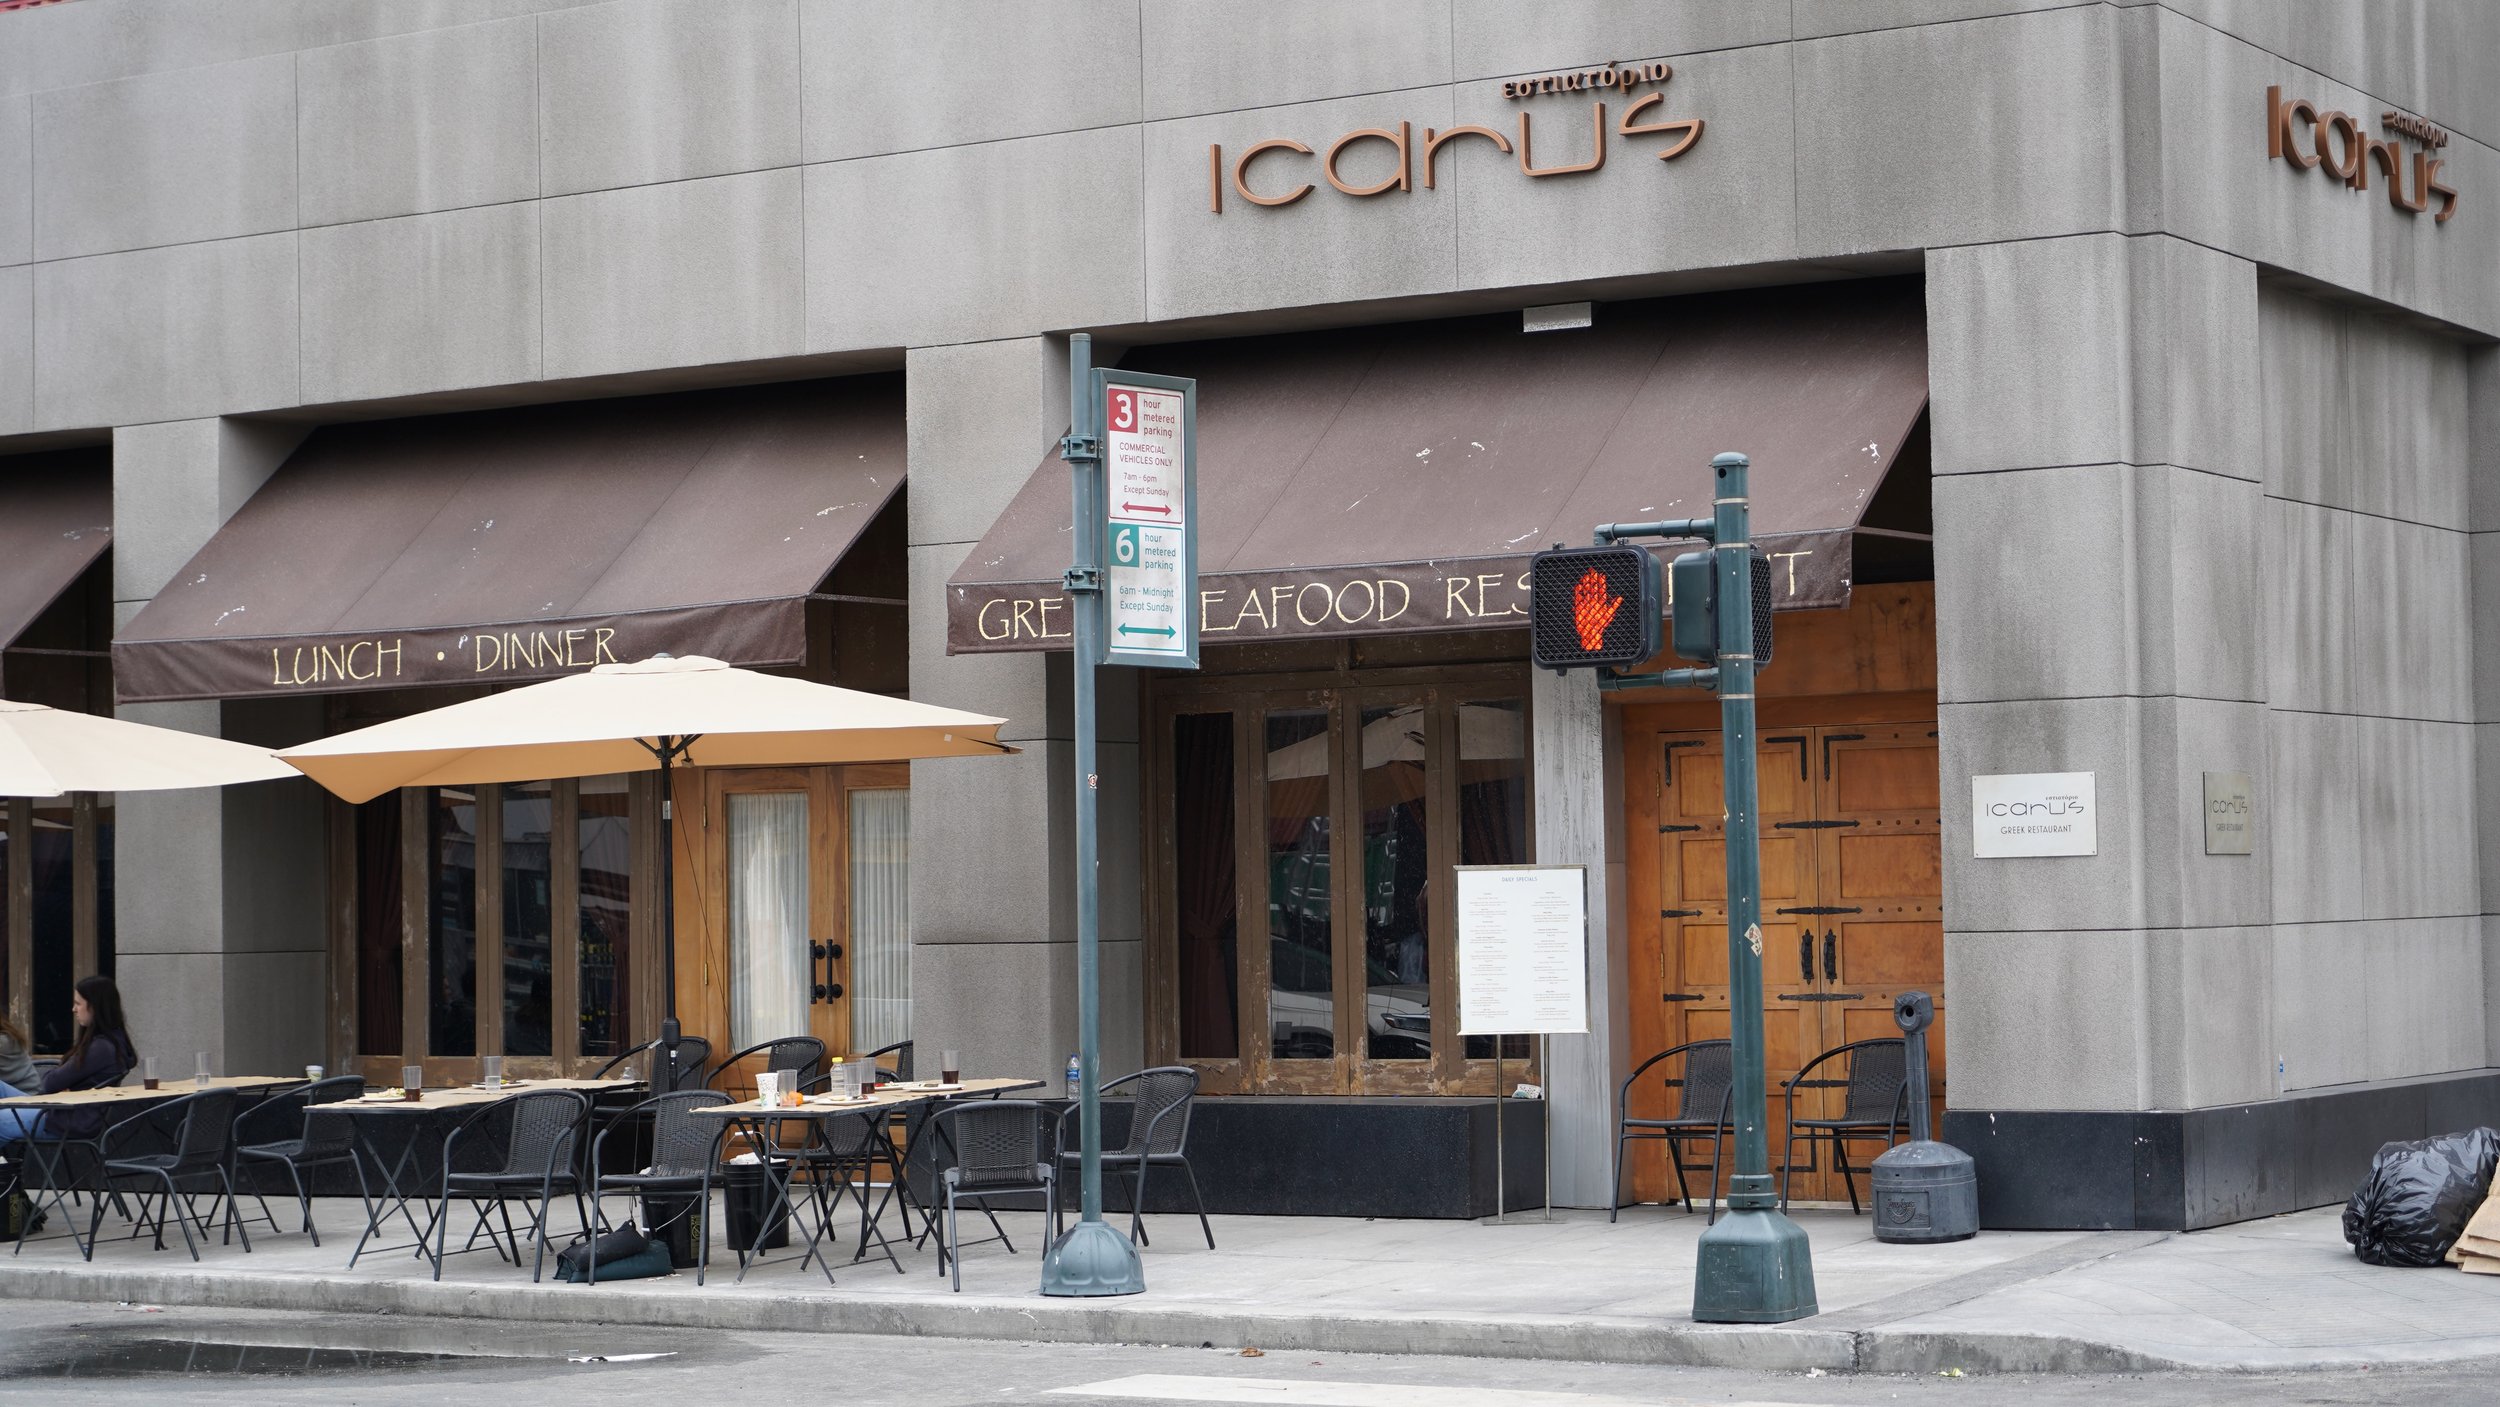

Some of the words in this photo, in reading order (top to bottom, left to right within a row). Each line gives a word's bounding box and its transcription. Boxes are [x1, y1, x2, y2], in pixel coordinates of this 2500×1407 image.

[1143, 399, 1161, 409] hour
[1114, 393, 1133, 429] 3
[1143, 413, 1175, 424] metered
[1143, 426, 1173, 439] parking
[1119, 442, 1166, 455] COMMERCIAL
[1119, 455, 1154, 465] VEHICLES
[1155, 457, 1173, 467] ONLY
[1123, 472, 1138, 480] 7am
[1142, 474, 1158, 483] 6pm
[1123, 485, 1145, 495] Except
[1146, 487, 1170, 497] Sunday
[1144, 533, 1162, 543] hour
[1115, 528, 1135, 563] 6
[1144, 547, 1176, 557] metered
[1144, 560, 1174, 573] parking
[1119, 585, 1136, 595] 6am
[1142, 587, 1174, 599] Midnight
[1120, 600, 1145, 611] Except
[1146, 602, 1173, 614] Sunday
[1201, 579, 1411, 633] EAFOOD
[273, 638, 402, 686] LUNCH
[475, 628, 618, 672] DINNER
[2000, 825, 2026, 835] GREEK
[2027, 824, 2072, 834] RESTAURANT
